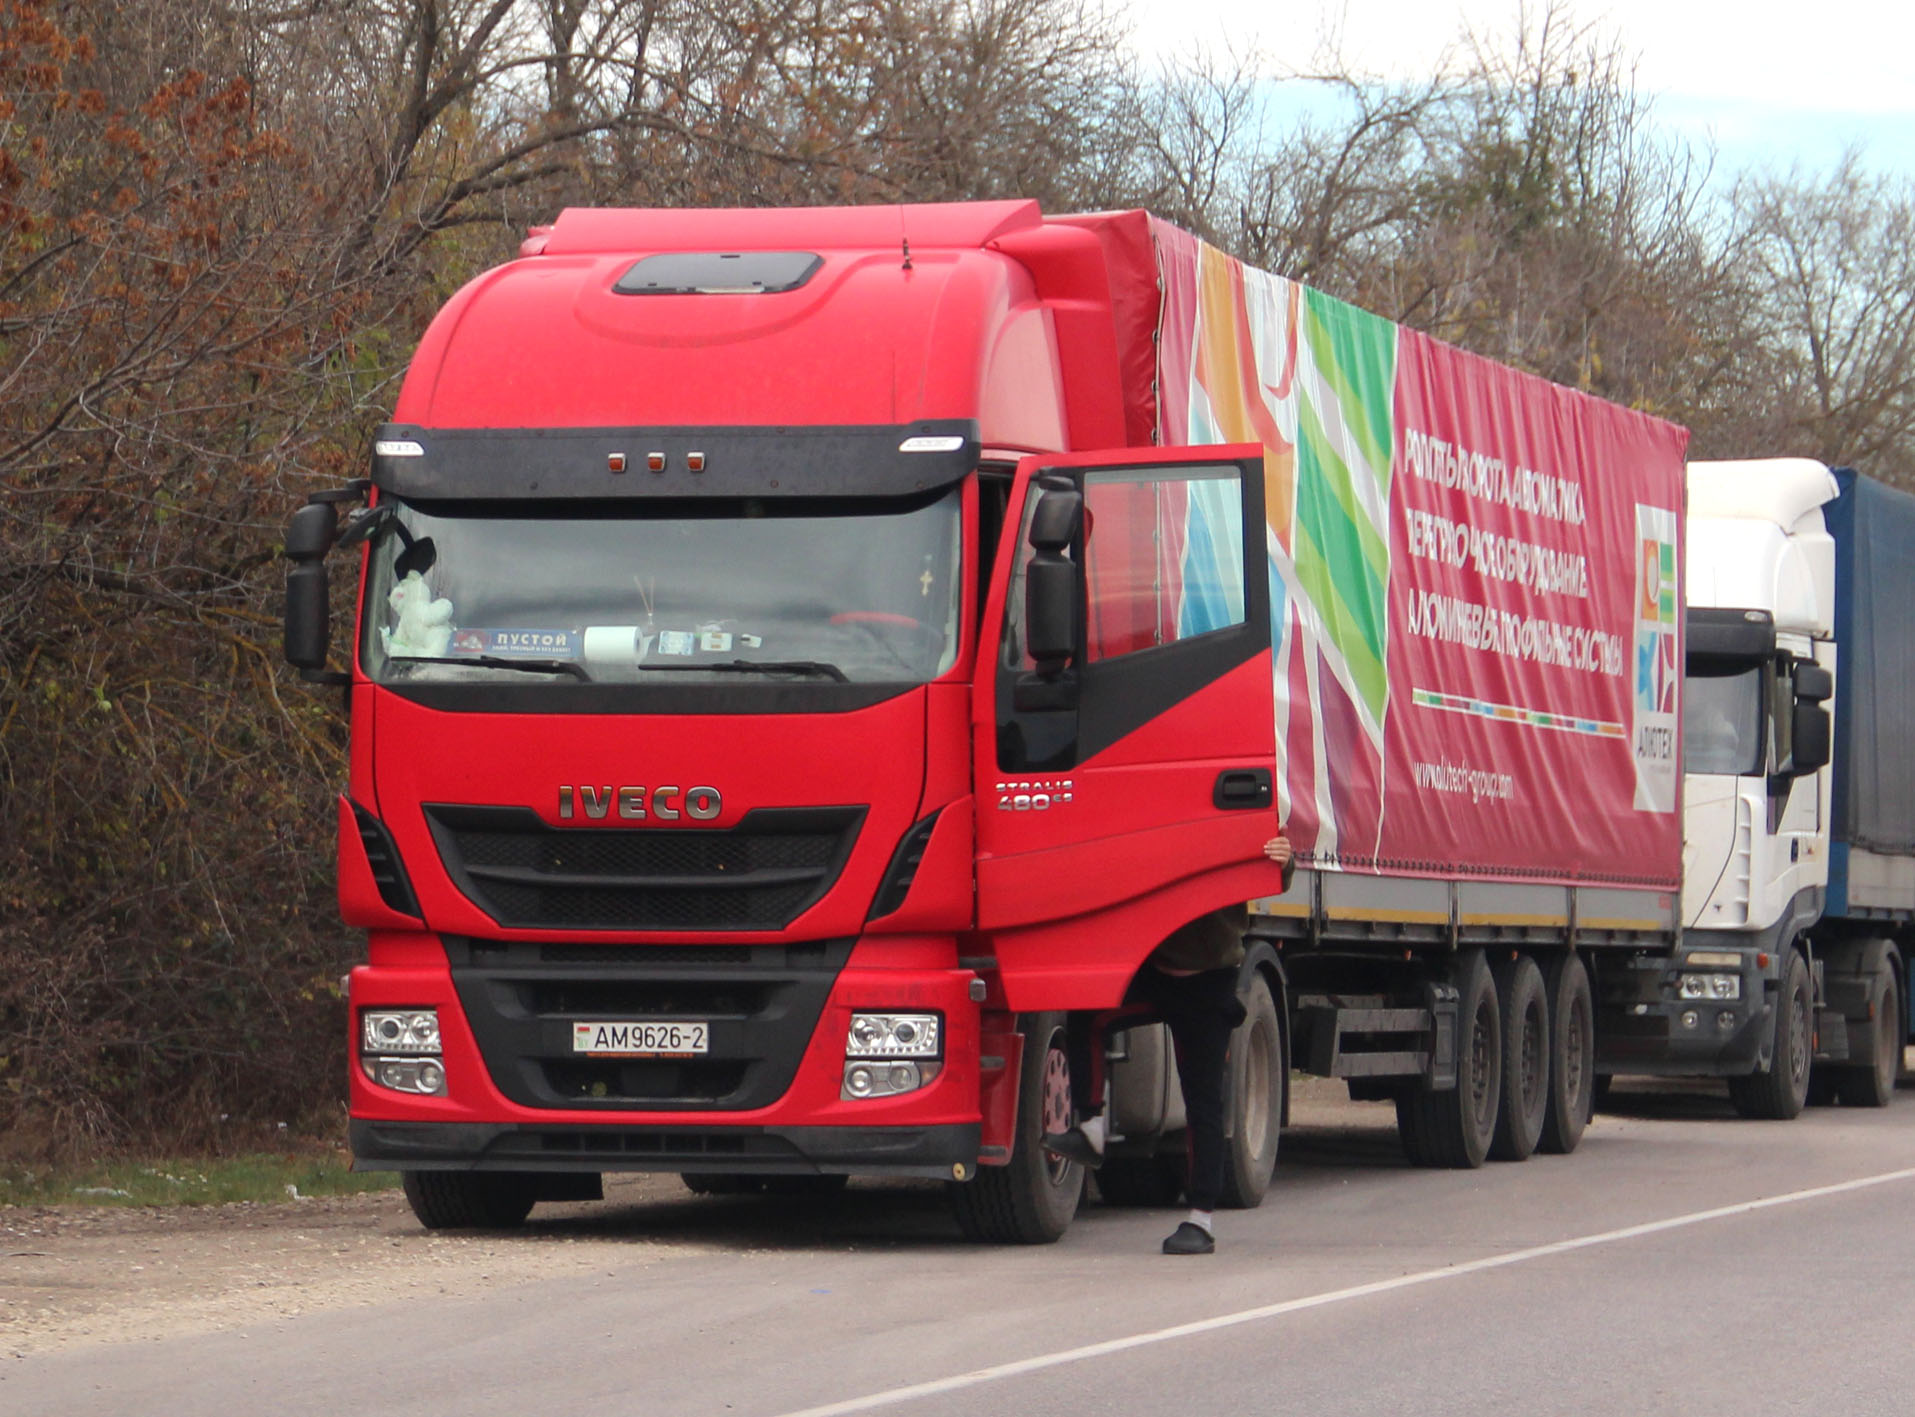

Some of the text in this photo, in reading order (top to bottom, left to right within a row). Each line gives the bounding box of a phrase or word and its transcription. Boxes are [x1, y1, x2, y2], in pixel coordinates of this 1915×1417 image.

[1408, 588, 1500, 654] АЛЮМИНЕВЫЕ
[497, 632, 567, 646] ПУСТОЙ
[559, 785, 722, 820] IVECO
